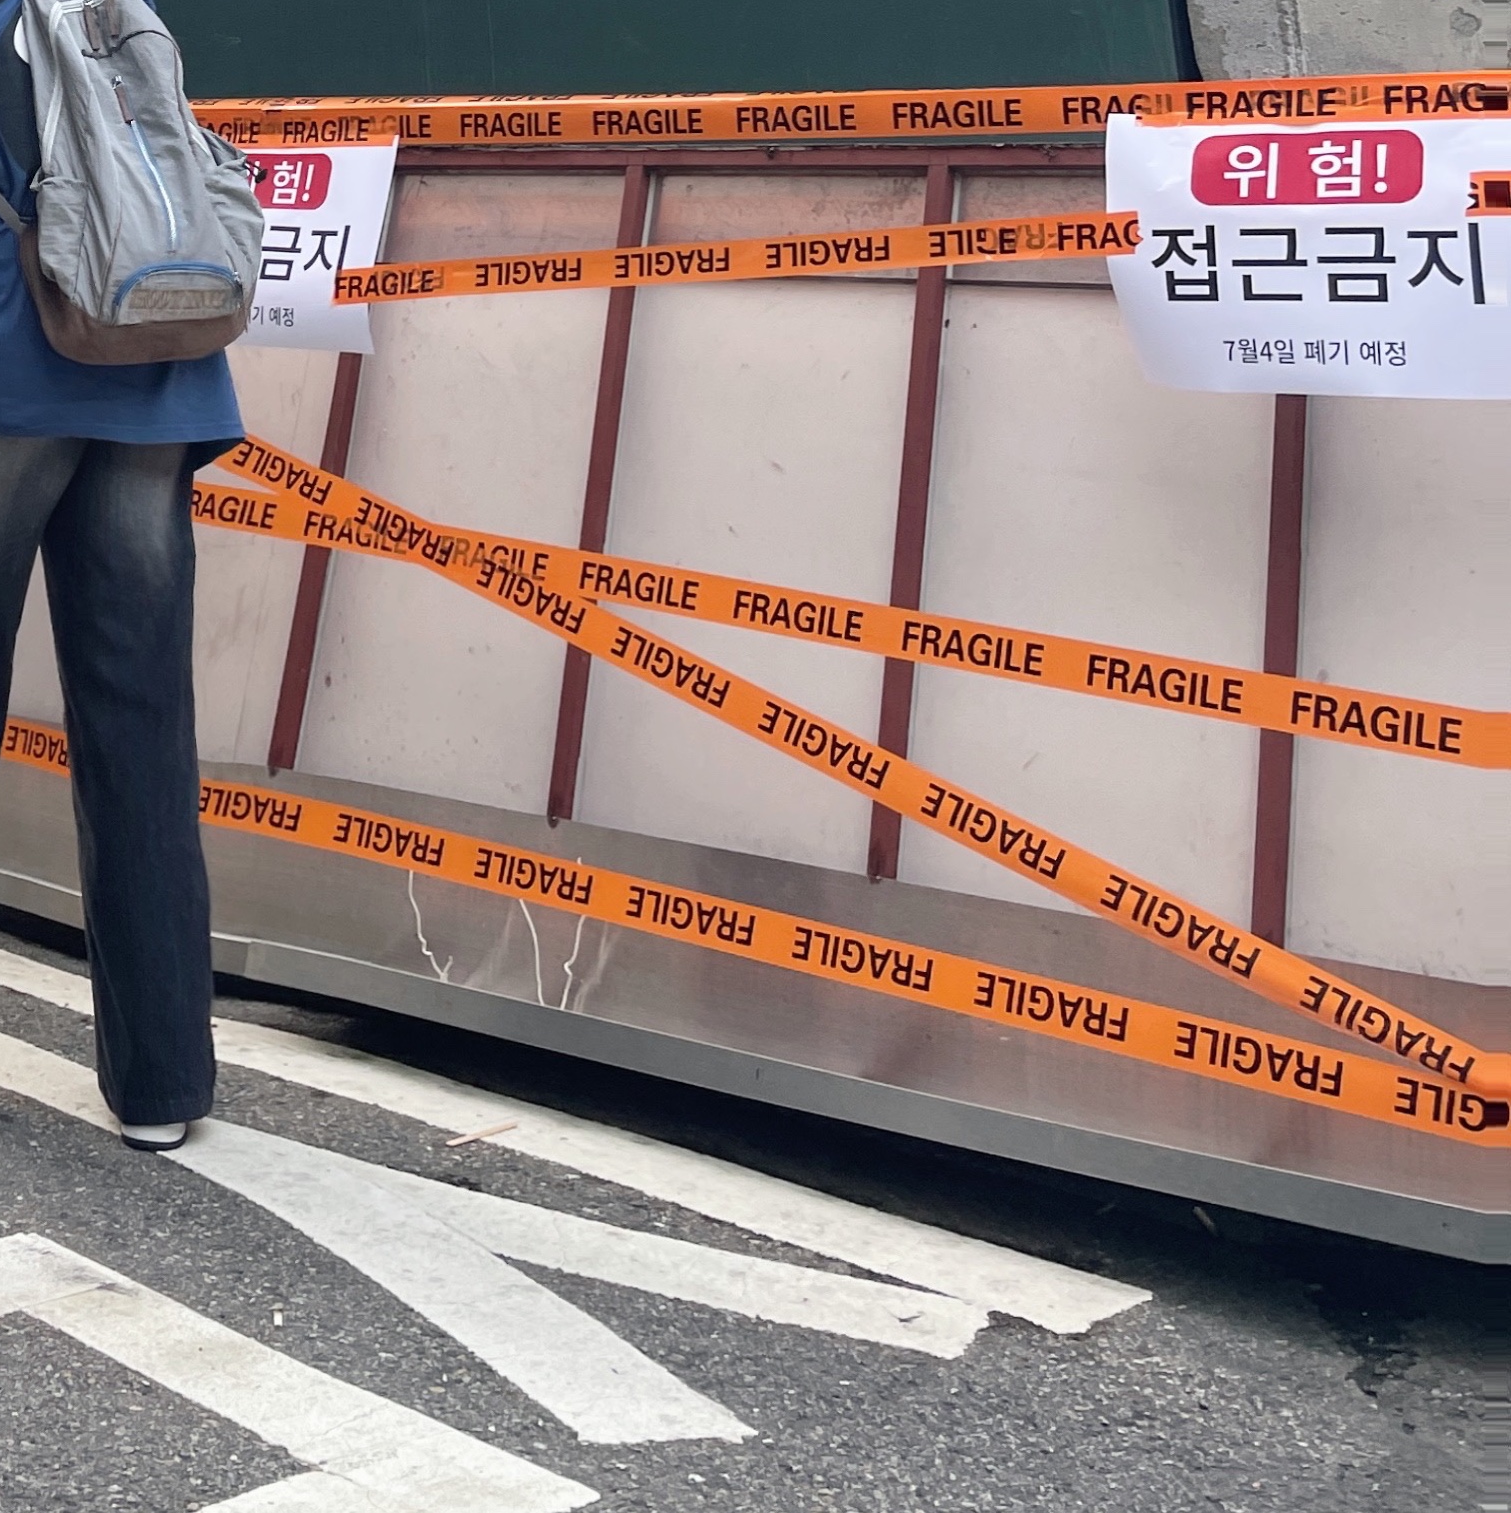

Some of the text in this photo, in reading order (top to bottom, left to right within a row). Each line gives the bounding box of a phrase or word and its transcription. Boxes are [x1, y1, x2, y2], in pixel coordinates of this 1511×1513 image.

[282, 119, 369, 143] FRAGILE
[459, 112, 562, 138] FRAGILE
[593, 108, 703, 136] FRAGILE
[735, 104, 857, 133] FRAGILE
[892, 98, 1023, 130] FRAGILE
[1188, 88, 1337, 119] FRAGILE
[334, 270, 435, 299] FRAGILE
[475, 257, 582, 288] FRAGILE
[614, 247, 731, 279] FRAGILE
[765, 235, 890, 270] FRAGILE
[1151, 221, 1486, 306] 접근금지
[268, 307, 295, 328] 예정
[1222, 338, 1407, 367] 7월4일 폐기 예정
[303, 510, 408, 555] FRAGILE
[579, 561, 700, 612] FRAGILE
[732, 590, 865, 643] FRAGILE
[901, 620, 1045, 677] FRAGILE
[1086, 654, 1245, 714] FRAGILE
[1290, 690, 1464, 755] FRAGILE
[232, 440, 1476, 1084] FRAGILE FRAGILE FRAGILE FRAGILE FRAGILE FRAGILE FRAGILE FRAGILE
[199, 786, 302, 832] FRAGILE
[334, 813, 445, 867] FRAGILE
[474, 847, 593, 905] FRAGILE
[626, 885, 757, 946] FRAGILE
[792, 926, 934, 992] FRAGILE
[973, 971, 1130, 1042] FRAGILE
[1174, 1020, 1345, 1098] FRAGILE
